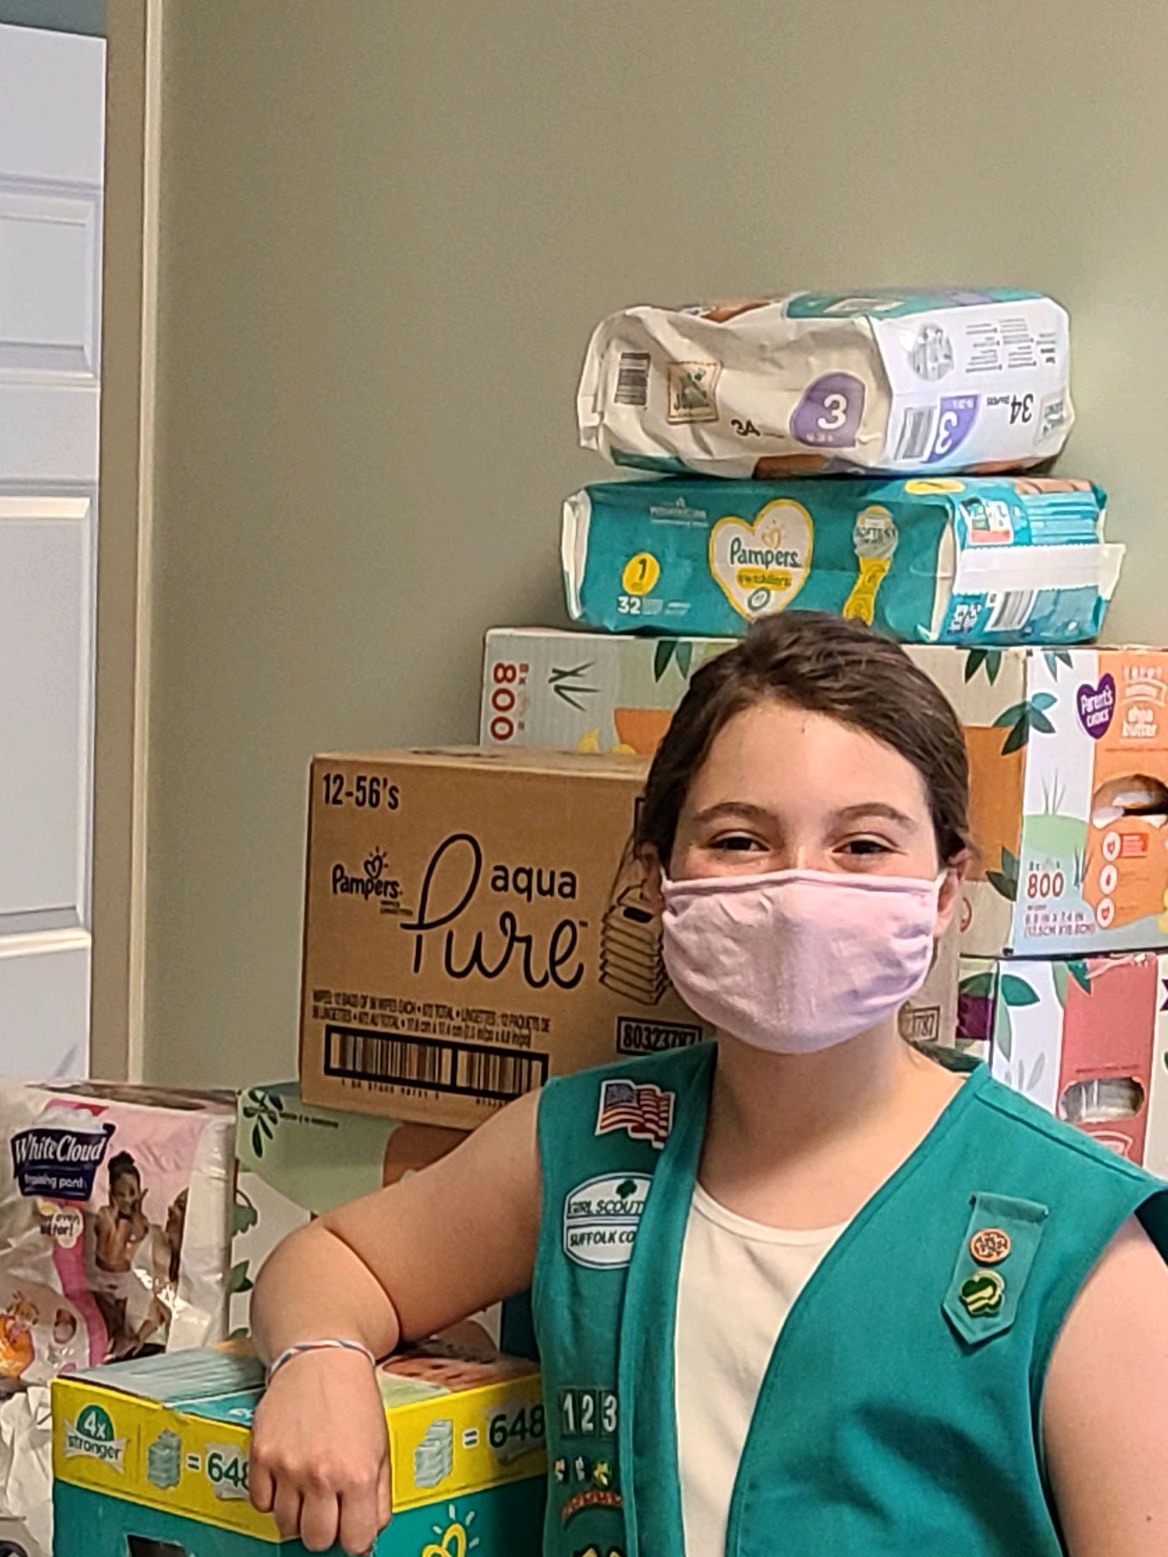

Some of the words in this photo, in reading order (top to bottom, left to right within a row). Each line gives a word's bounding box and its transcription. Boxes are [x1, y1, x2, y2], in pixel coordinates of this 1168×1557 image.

[816, 393, 849, 430] 3
[636, 557, 649, 582] 1
[730, 536, 802, 570] Pampers
[616, 596, 643, 616] 32
[489, 661, 518, 741] 800
[322, 773, 400, 811] 12-56's
[331, 863, 401, 901] Pampers
[490, 864, 577, 903] aqua
[1027, 871, 1064, 899] 800
[399, 833, 584, 989] Pure
[58, 1177, 87, 1190] pant
[569, 1231, 616, 1247] SUFFOLK
[83, 1411, 106, 1440] 4x
[489, 1403, 546, 1449] 648
[67, 1432, 121, 1460] stronger
